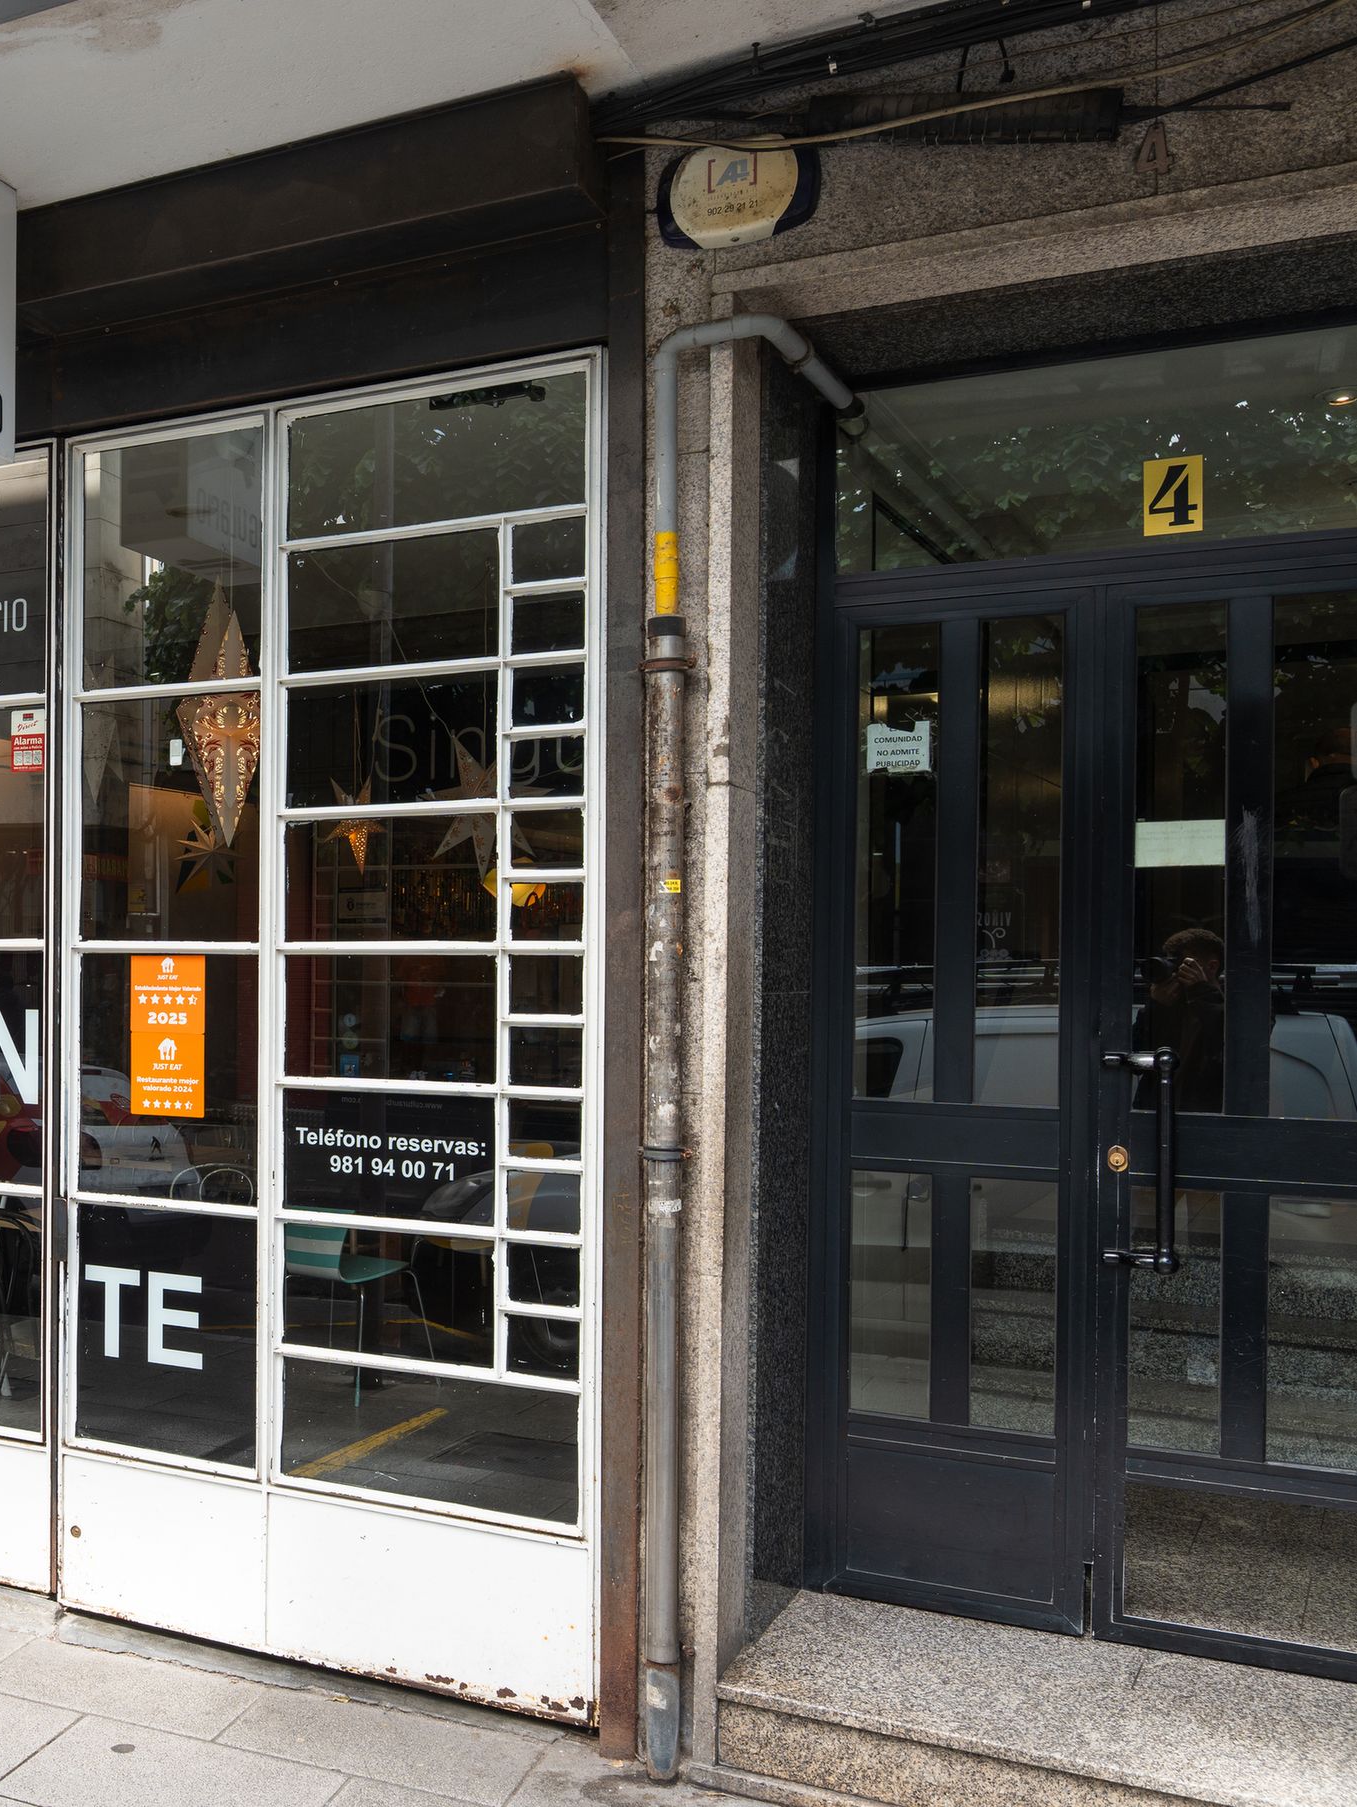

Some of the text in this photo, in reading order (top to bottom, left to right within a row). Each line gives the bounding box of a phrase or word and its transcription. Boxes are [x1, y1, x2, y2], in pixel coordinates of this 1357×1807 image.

[1136, 122, 1169, 174] 4
[707, 206, 722, 217] 902
[724, 204, 735, 214] 29
[749, 199, 758, 209] 21
[1148, 464, 1199, 527] 4
[14, 737, 43, 745] Alarma
[874, 735, 922, 744] COMUNIDAD
[890, 748, 920, 756] ADMITE
[875, 759, 920, 767] PUBLICIDAD
[147, 1011, 188, 1025] 2025
[169, 1063, 183, 1071] EAT
[136, 1076, 199, 1086] Restaurante mejor
[142, 1085, 172, 1093] valorado
[295, 1126, 486, 1156] Teléfono reservas:
[329, 1154, 455, 1182] 981 94 00 71
[85, 1263, 204, 1371] TE
